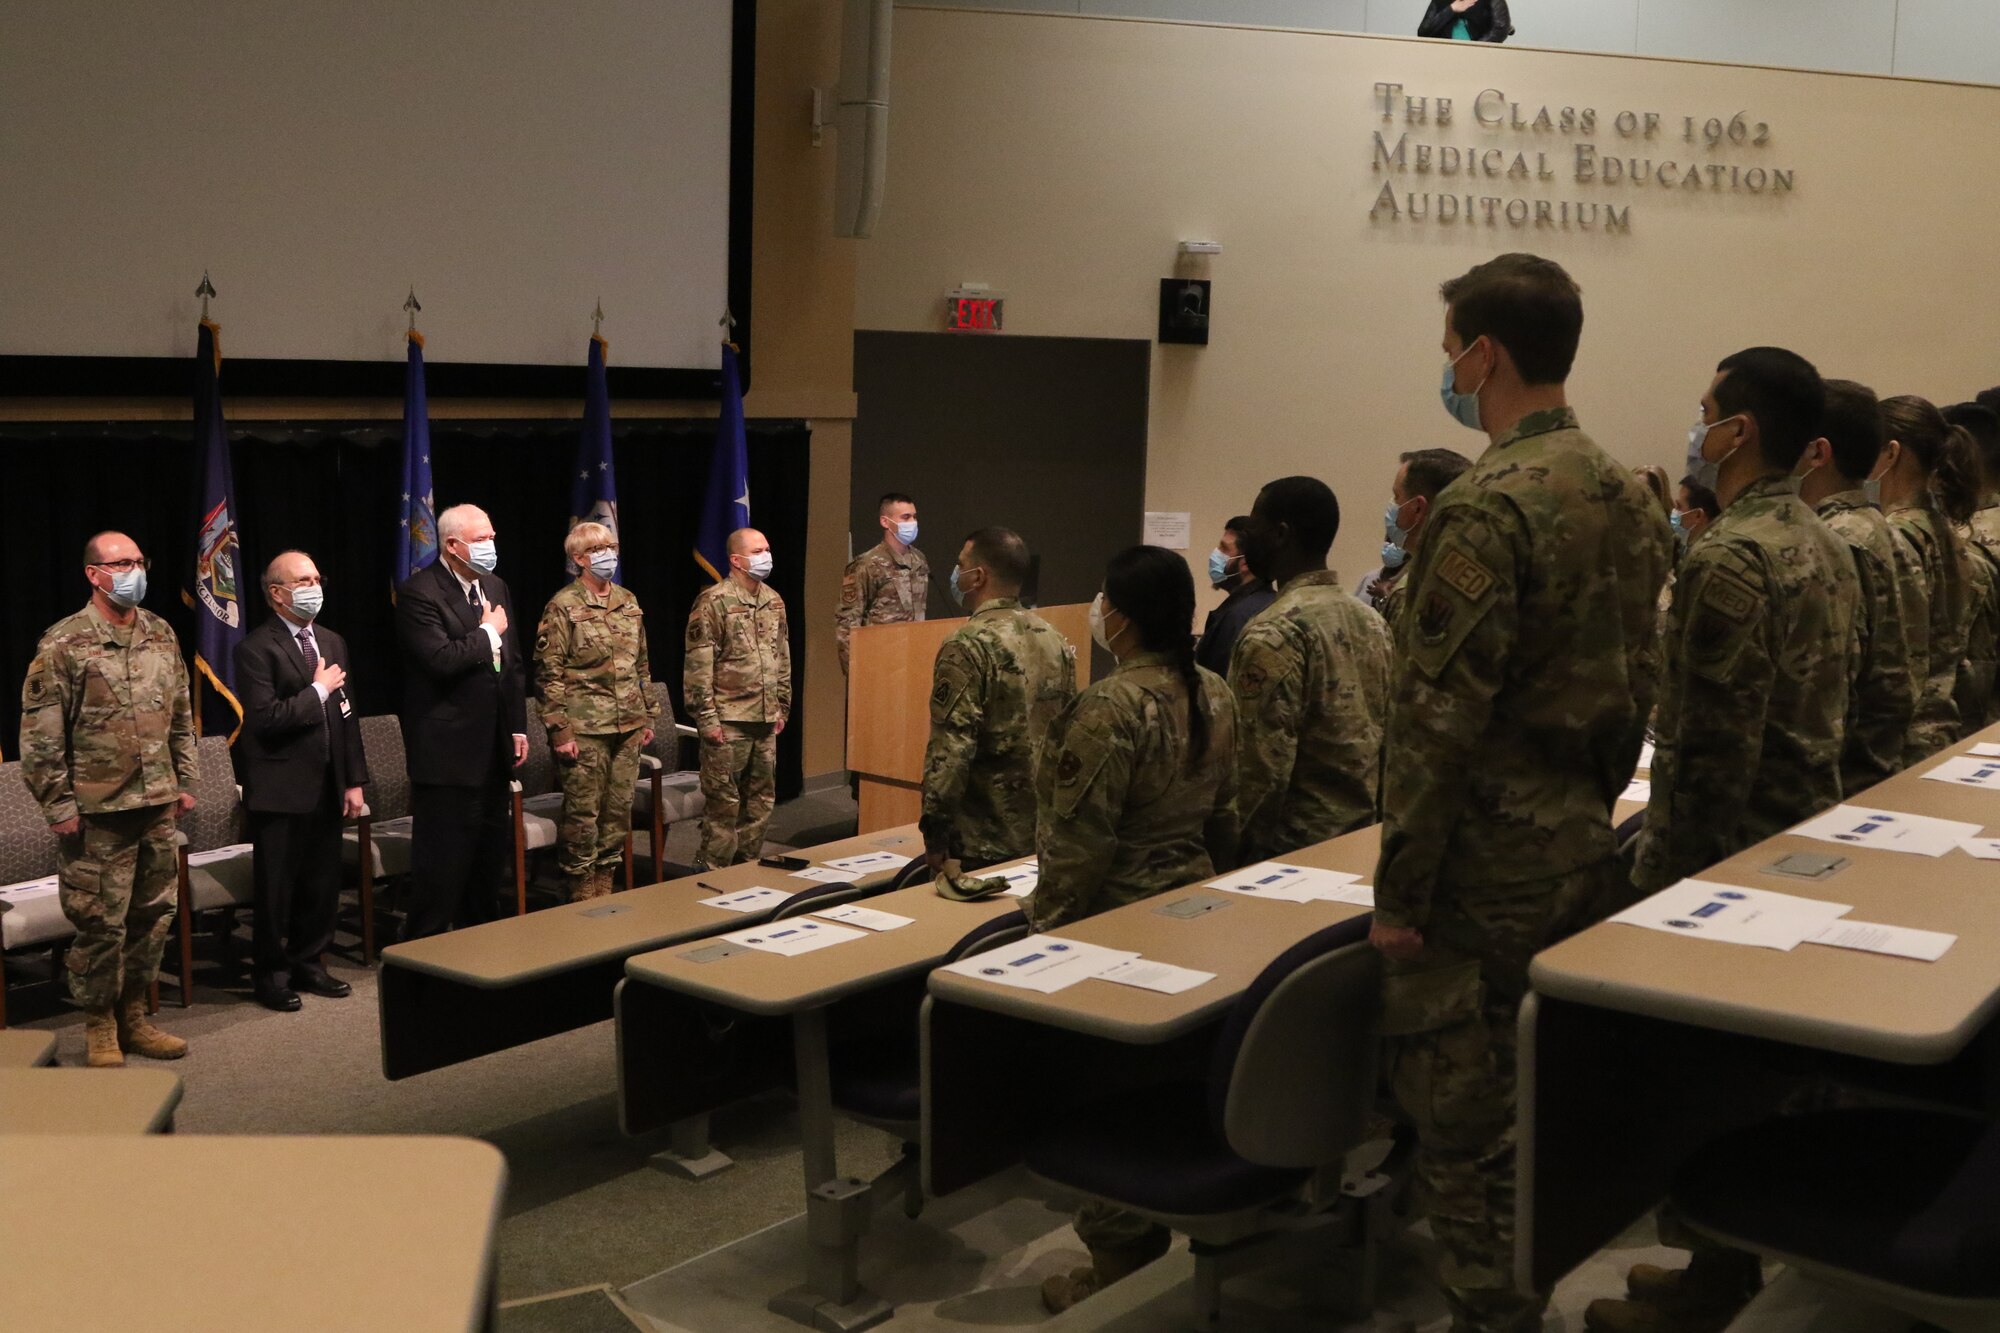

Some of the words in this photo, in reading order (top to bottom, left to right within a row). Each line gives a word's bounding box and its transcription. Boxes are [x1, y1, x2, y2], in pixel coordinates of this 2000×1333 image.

[1473, 88, 1597, 135] CLASS
[1614, 110, 1660, 138] OF
[1682, 110, 1770, 147] 1962
[1372, 131, 1555, 178] MEDICAL
[1574, 143, 1795, 192] EDUCATION
[1369, 180, 1633, 235] AUDITORIUM
[958, 299, 997, 328] EXIT
[1442, 553, 1486, 594] MED
[1706, 582, 1748, 613] MED
